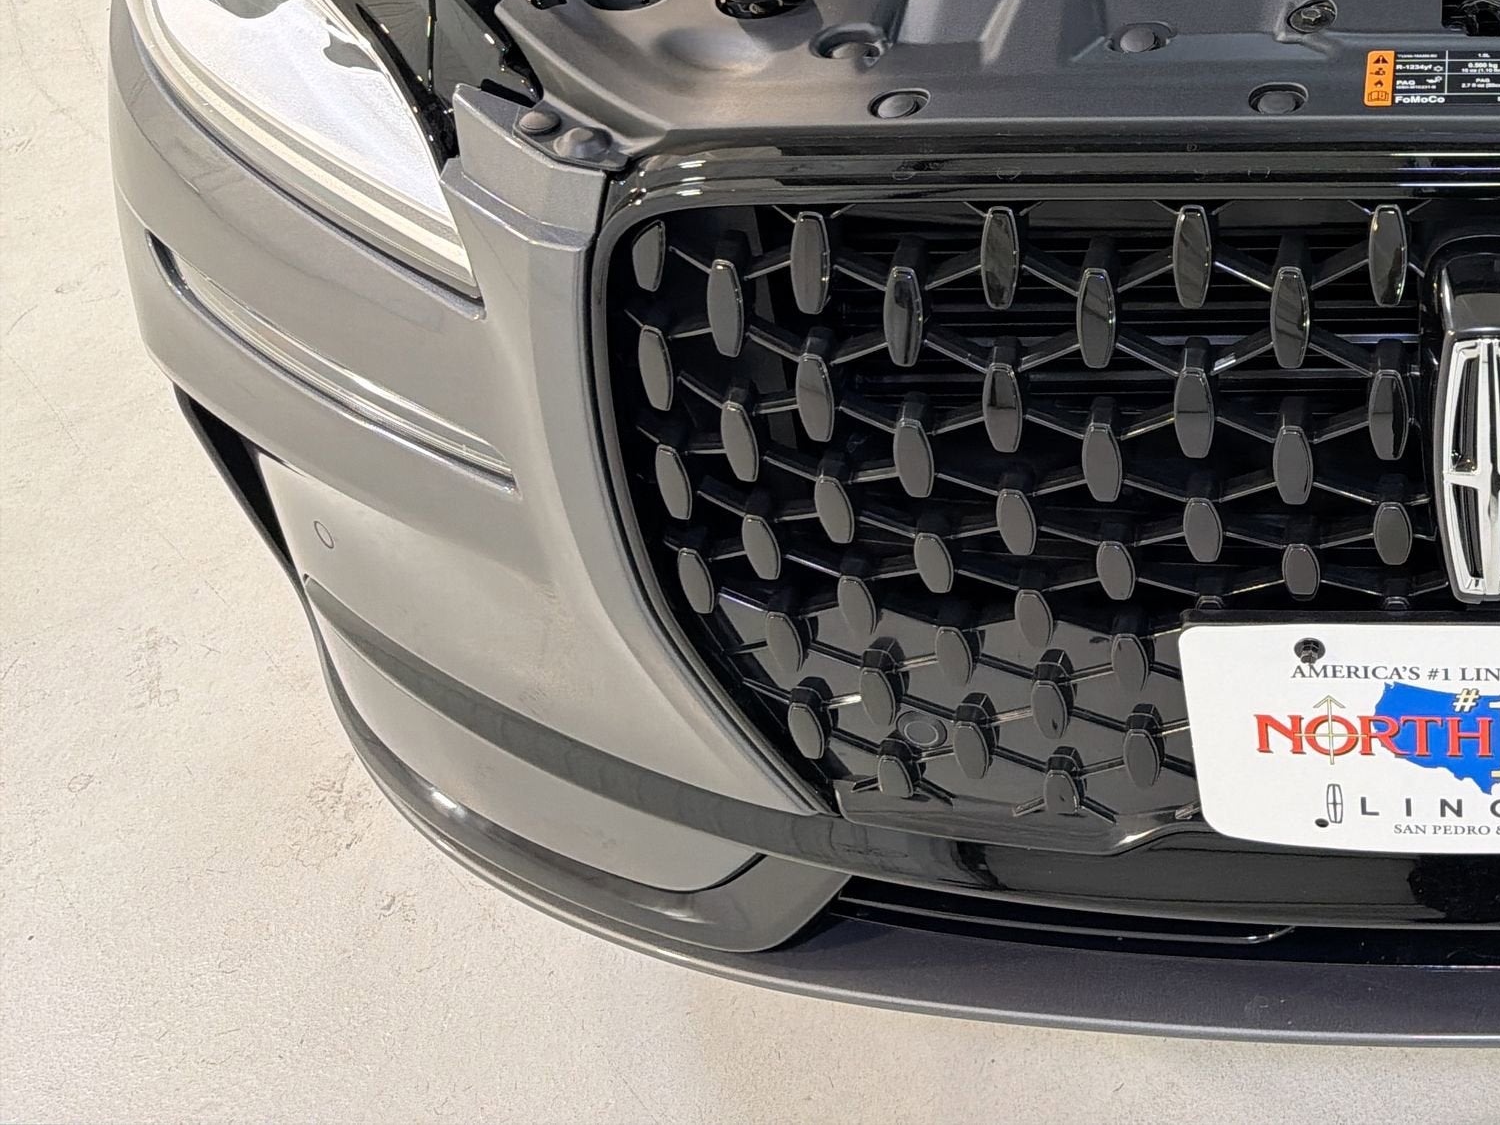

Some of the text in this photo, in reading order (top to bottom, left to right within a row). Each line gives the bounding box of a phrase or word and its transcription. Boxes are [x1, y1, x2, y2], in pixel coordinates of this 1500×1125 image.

[1395, 95, 1446, 104] FoMoCo
[1290, 665, 1421, 681] AMERICA'S
[1426, 667, 1452, 681] #1
[1254, 714, 1494, 758] NORTH
[1393, 824, 1427, 835] SAN
[1432, 825, 1491, 835] PEDRO
